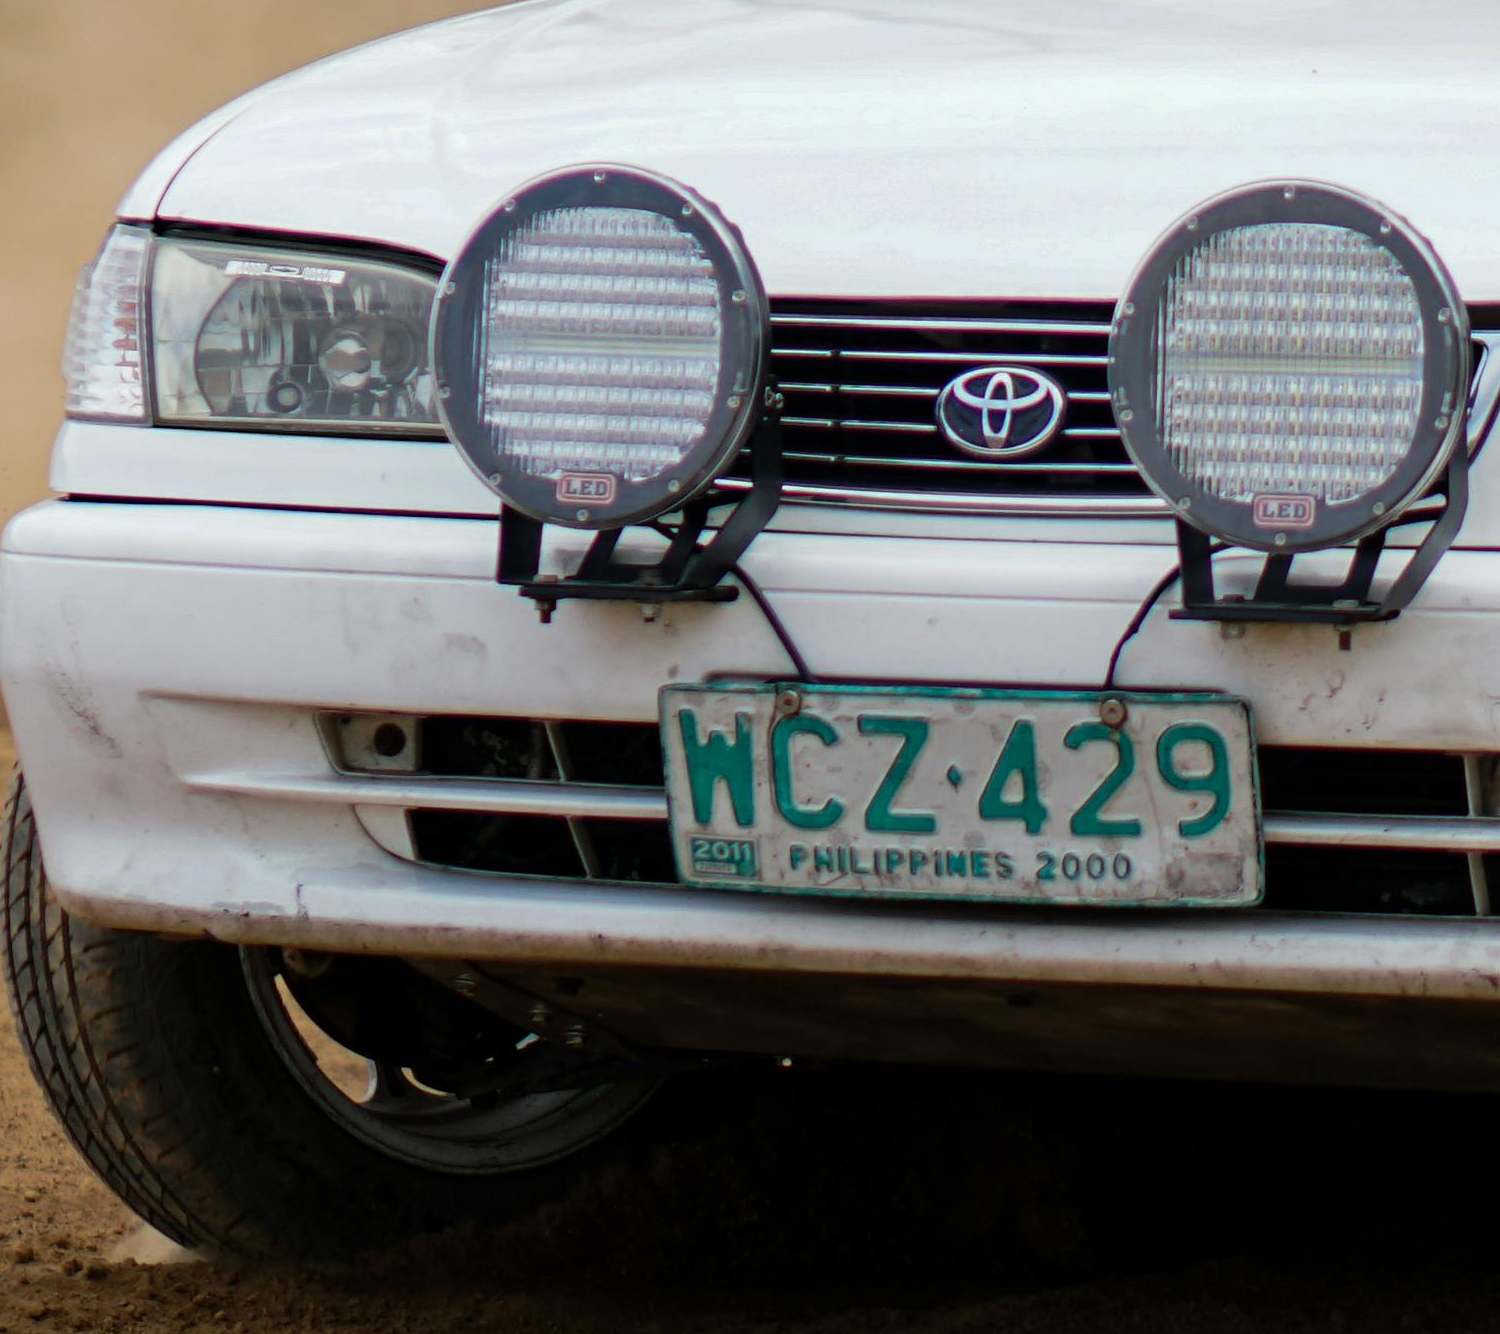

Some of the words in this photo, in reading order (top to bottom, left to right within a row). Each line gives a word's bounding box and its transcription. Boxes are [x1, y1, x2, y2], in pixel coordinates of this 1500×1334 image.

[563, 479, 607, 497] LED
[1261, 502, 1307, 520] LED
[694, 839, 752, 861] 2011
[788, 843, 1014, 881] PHILIPPINES
[1036, 851, 1133, 881] 2000
